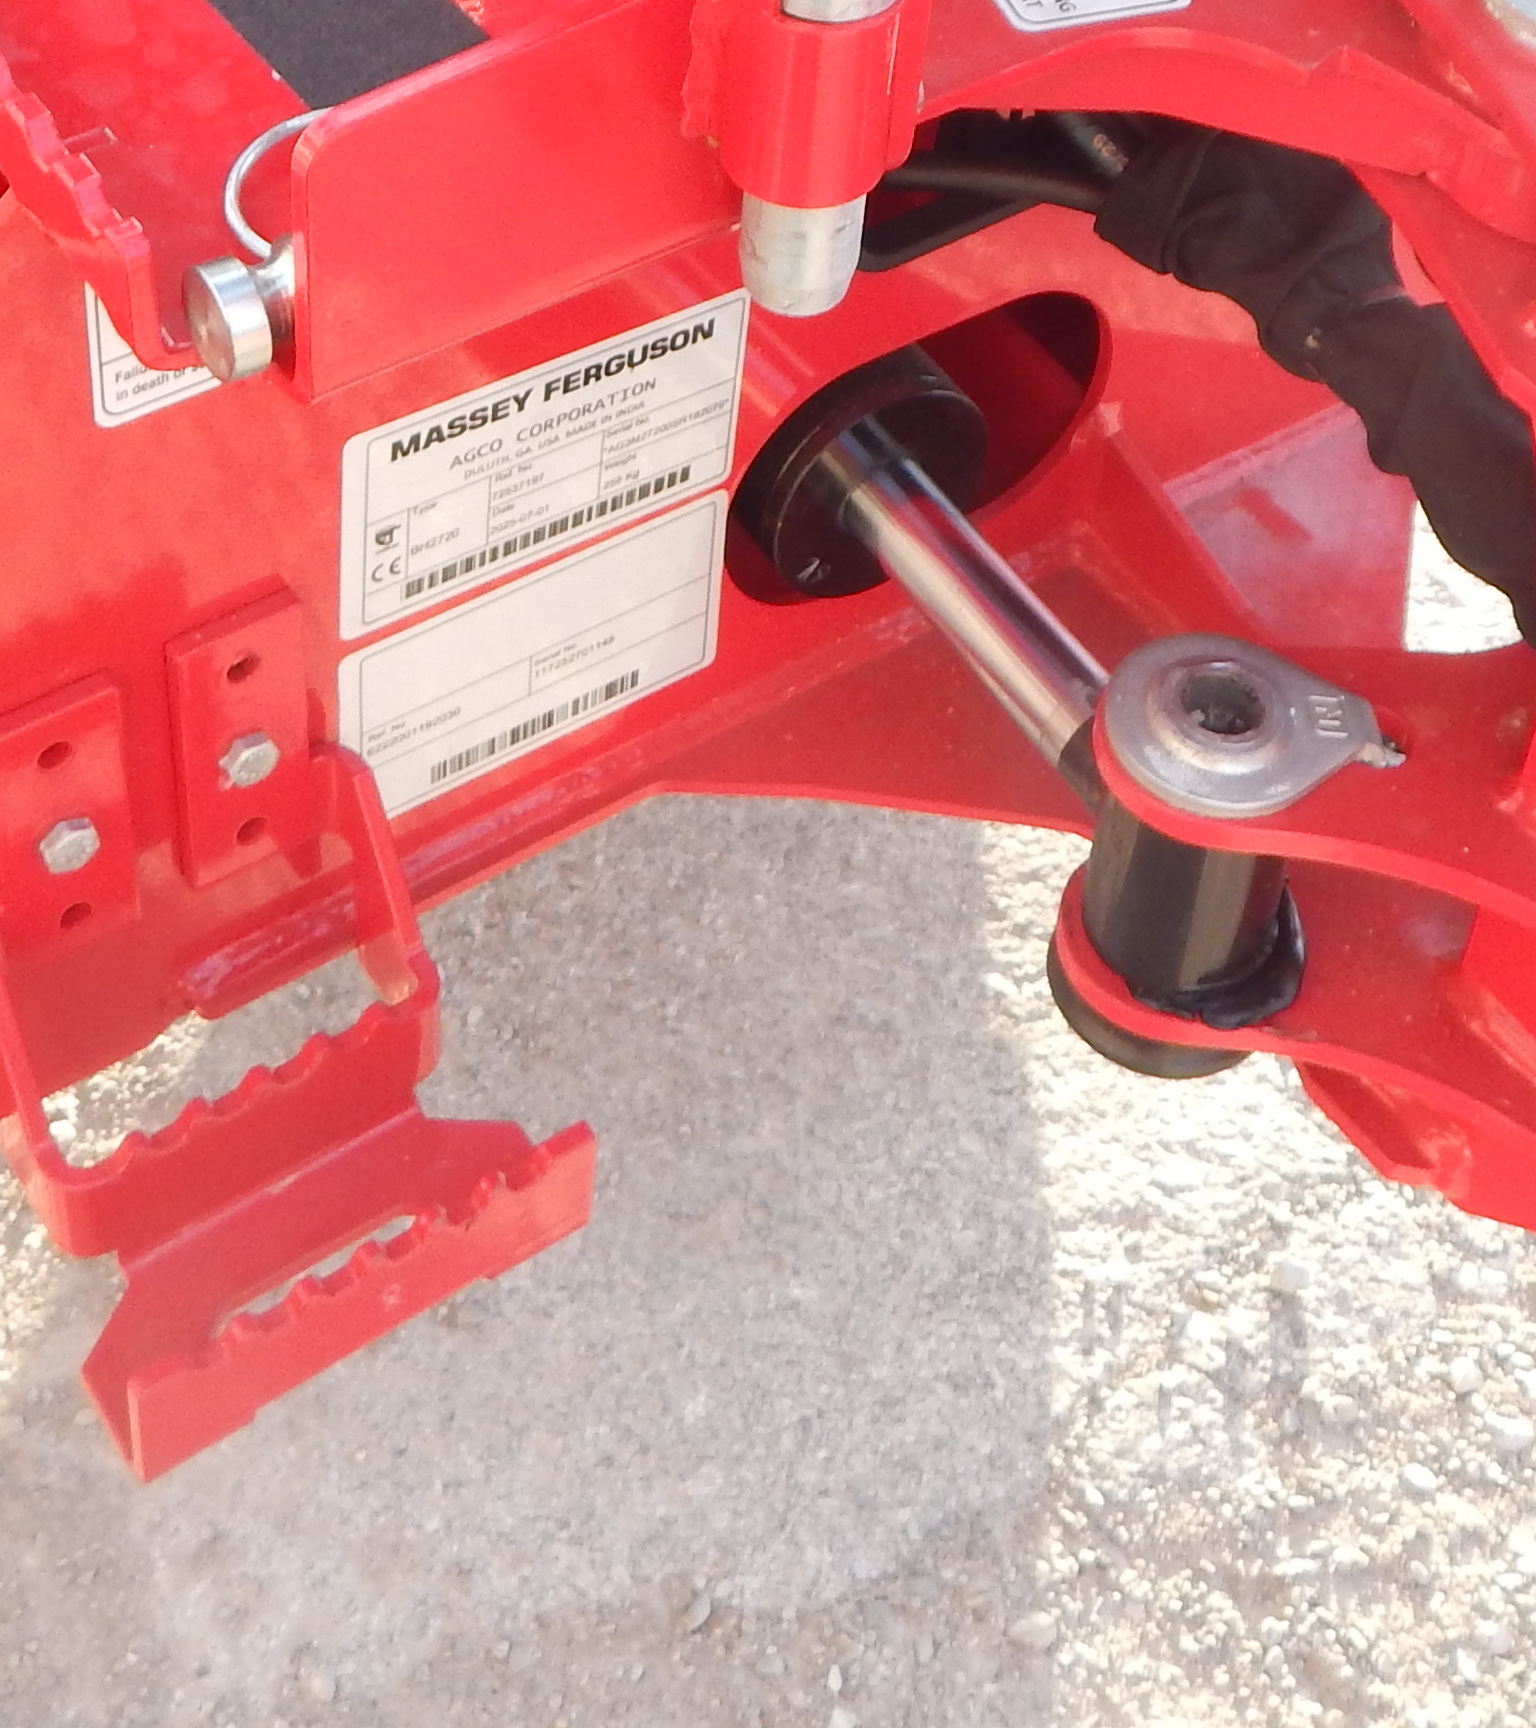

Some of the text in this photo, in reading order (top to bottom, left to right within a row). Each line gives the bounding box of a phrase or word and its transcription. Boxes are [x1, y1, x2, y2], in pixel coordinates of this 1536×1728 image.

[116, 388, 129, 401] in
[132, 373, 170, 395] death
[390, 317, 717, 462] MASSEY FERGUSON
[565, 421, 598, 438] MADE
[615, 400, 646, 419] INDIA
[449, 377, 657, 470] AGCO CORPORATION
